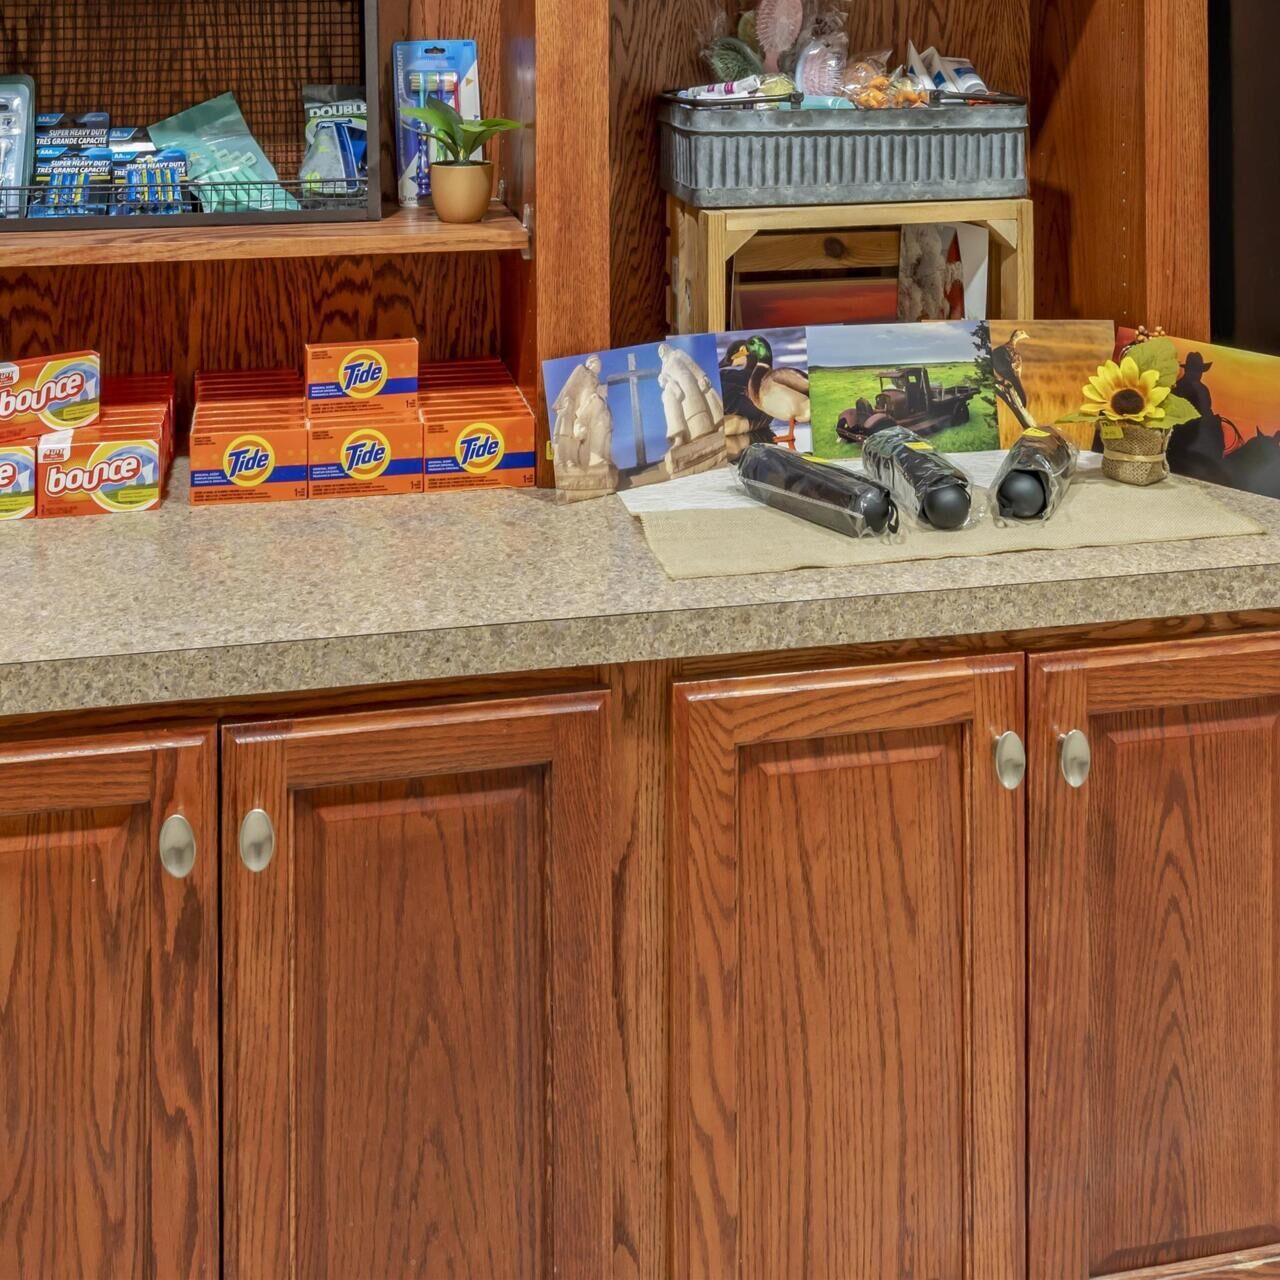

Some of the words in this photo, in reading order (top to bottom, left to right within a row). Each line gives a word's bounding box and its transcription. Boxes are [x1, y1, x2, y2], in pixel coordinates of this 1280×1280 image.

[343, 361, 382, 392] Tide
[227, 447, 270, 480] Tide
[345, 441, 386, 473] Tide
[460, 434, 500, 467] Tide
[47, 456, 142, 496] bounce
